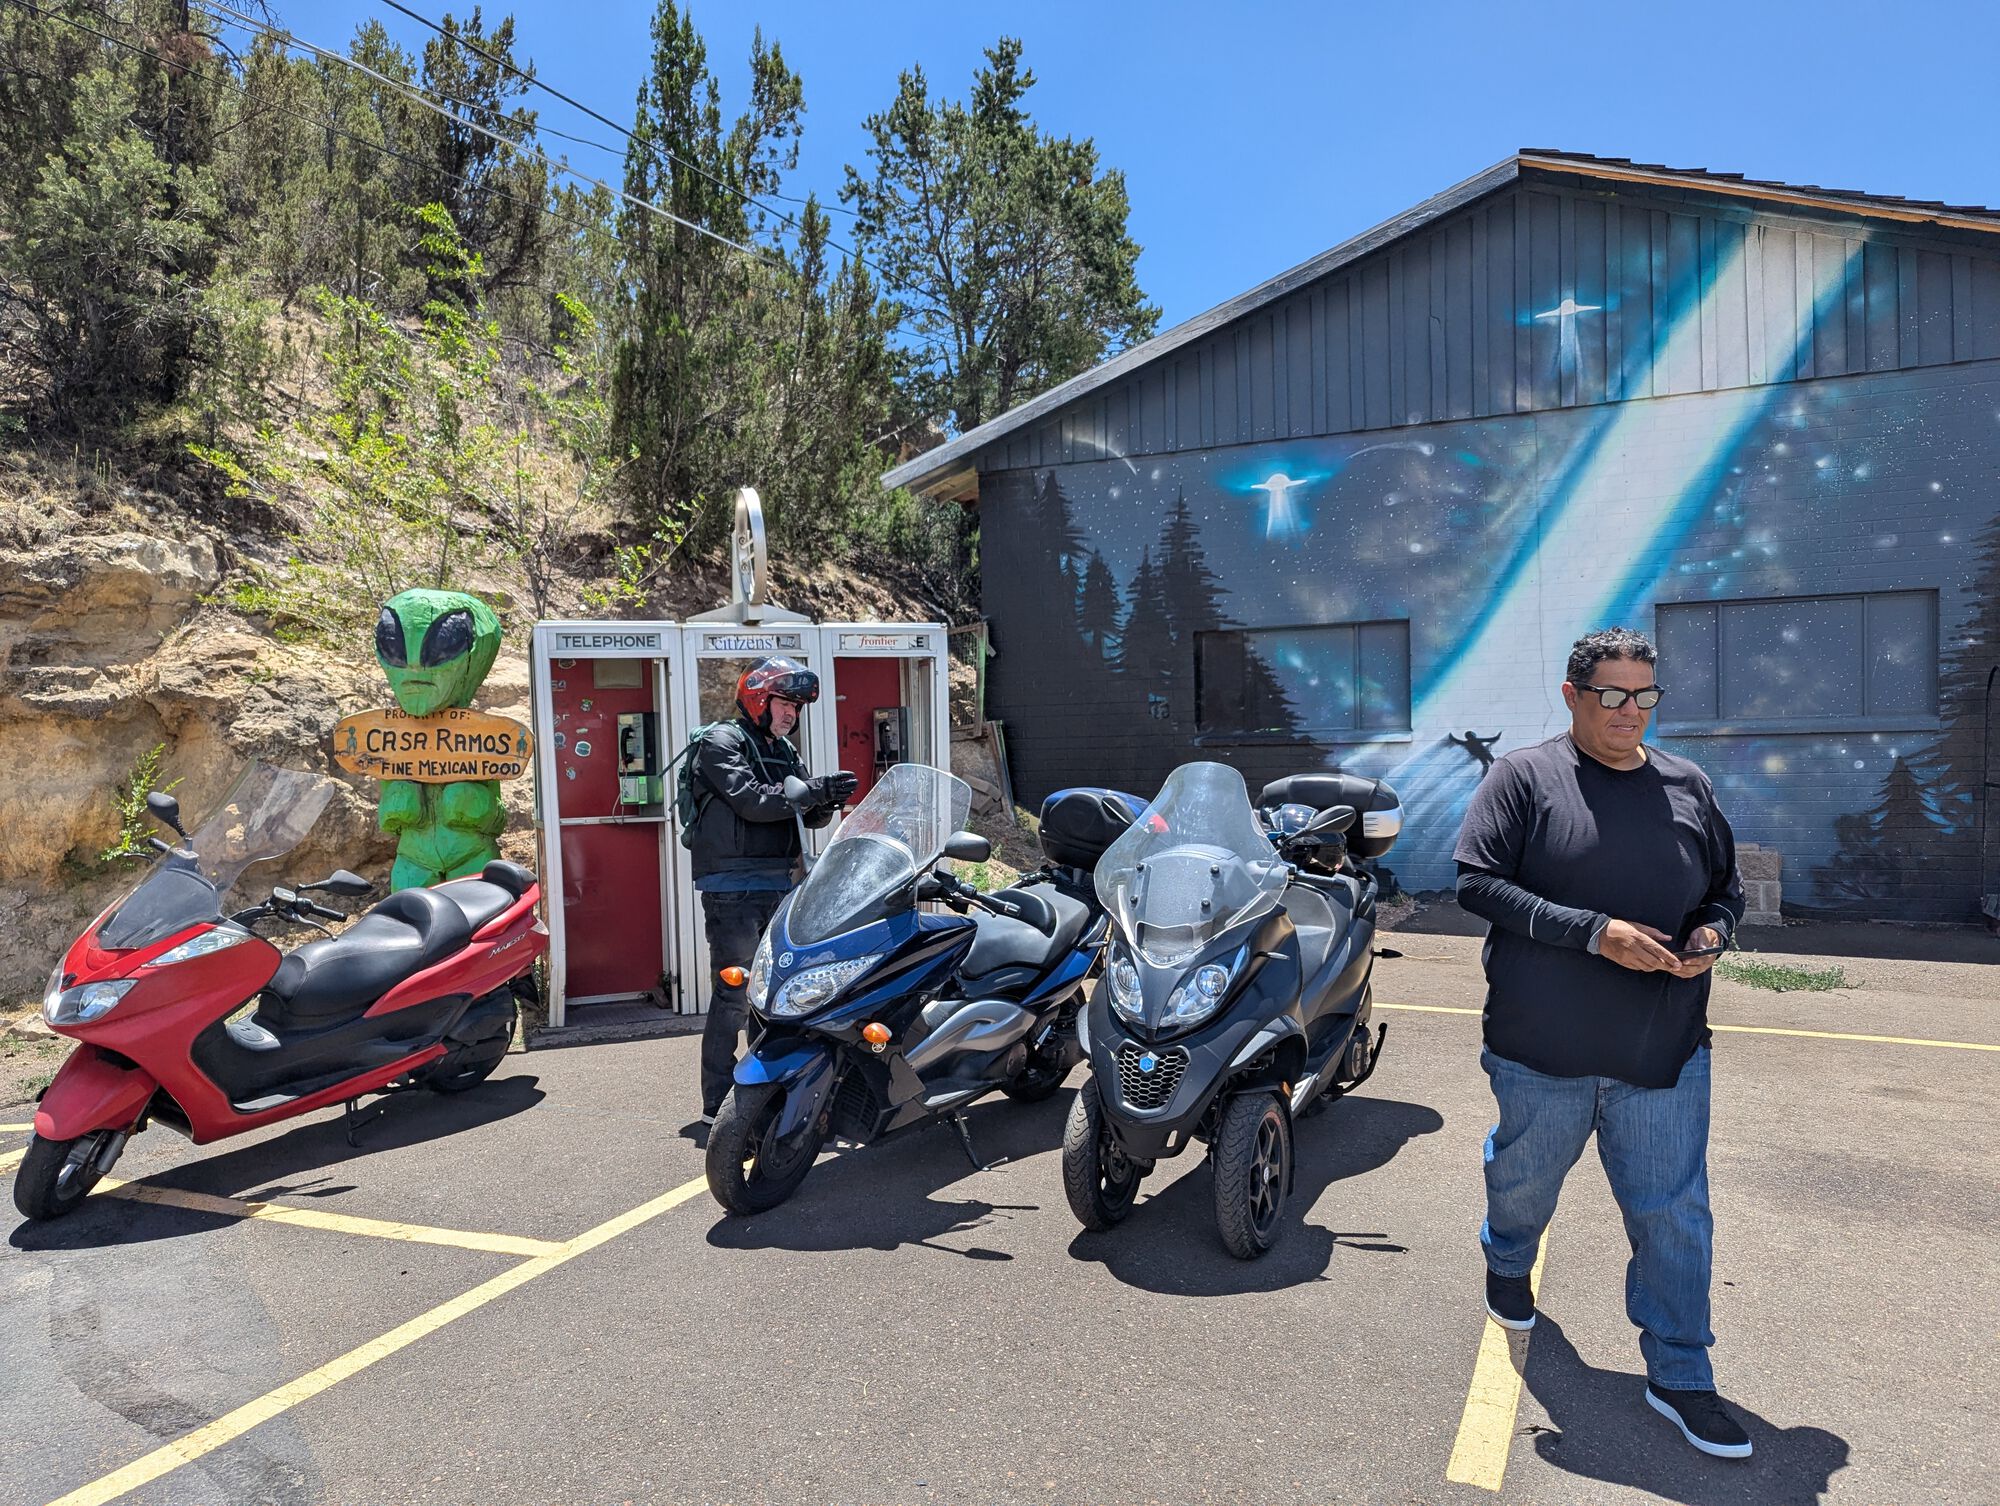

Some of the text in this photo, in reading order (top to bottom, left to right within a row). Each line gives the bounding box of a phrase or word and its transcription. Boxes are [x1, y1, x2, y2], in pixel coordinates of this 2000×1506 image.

[562, 635, 656, 648] TELEPHONE
[859, 635, 897, 648] frontier
[449, 710, 470, 720] OF:
[366, 728, 511, 755] CASA RAMOS
[381, 760, 521, 776] FINE MEXICAN FOOD
